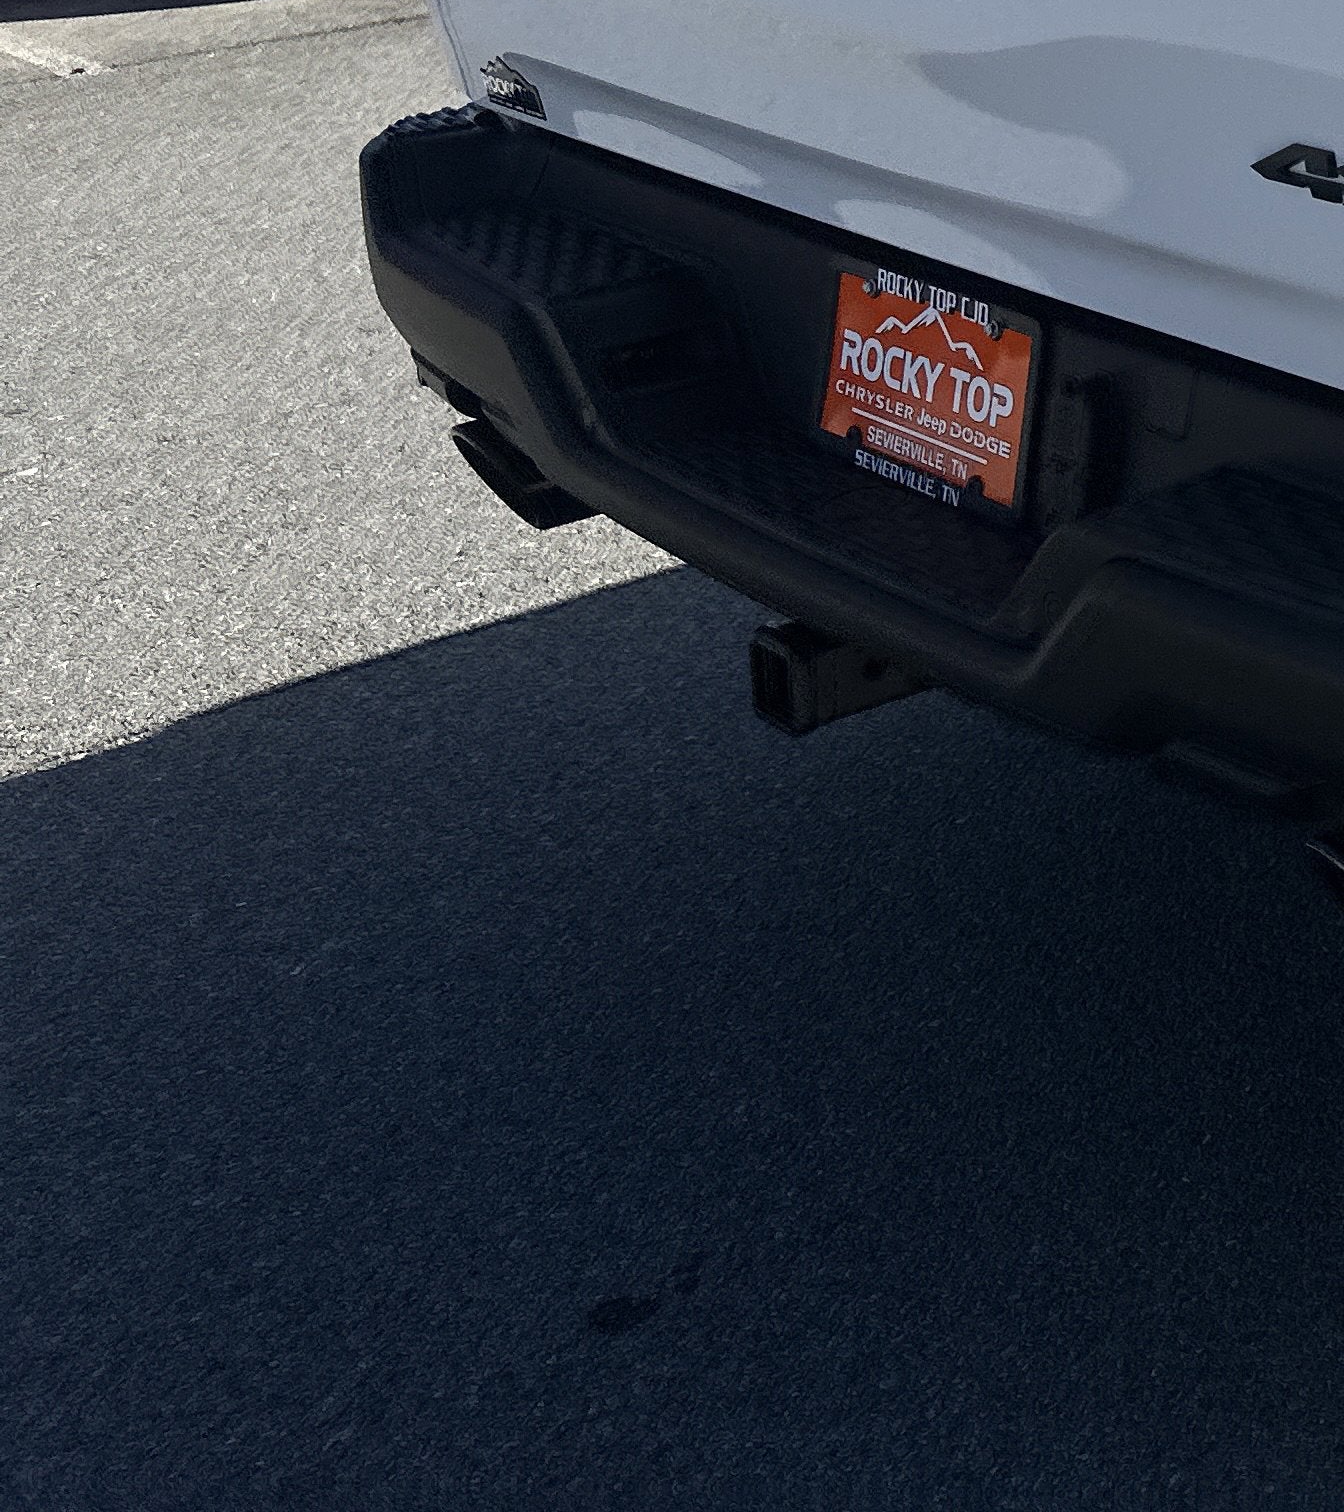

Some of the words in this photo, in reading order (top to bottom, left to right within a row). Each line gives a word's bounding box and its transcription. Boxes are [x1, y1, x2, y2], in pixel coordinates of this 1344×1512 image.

[877, 268, 925, 304] ROCKY
[928, 285, 957, 314] TOP
[961, 296, 989, 327] CJD
[840, 328, 945, 403] ROCKY
[950, 367, 1014, 428] TOP
[835, 379, 914, 420] CHRYSLER
[916, 407, 947, 435] Jeep
[949, 421, 1011, 459] DODGE
[854, 449, 936, 499] SEVIERVILLE,
[942, 484, 960, 507] TN
[866, 425, 946, 475] SEVIERVILLE,
[951, 459, 968, 481] TN
